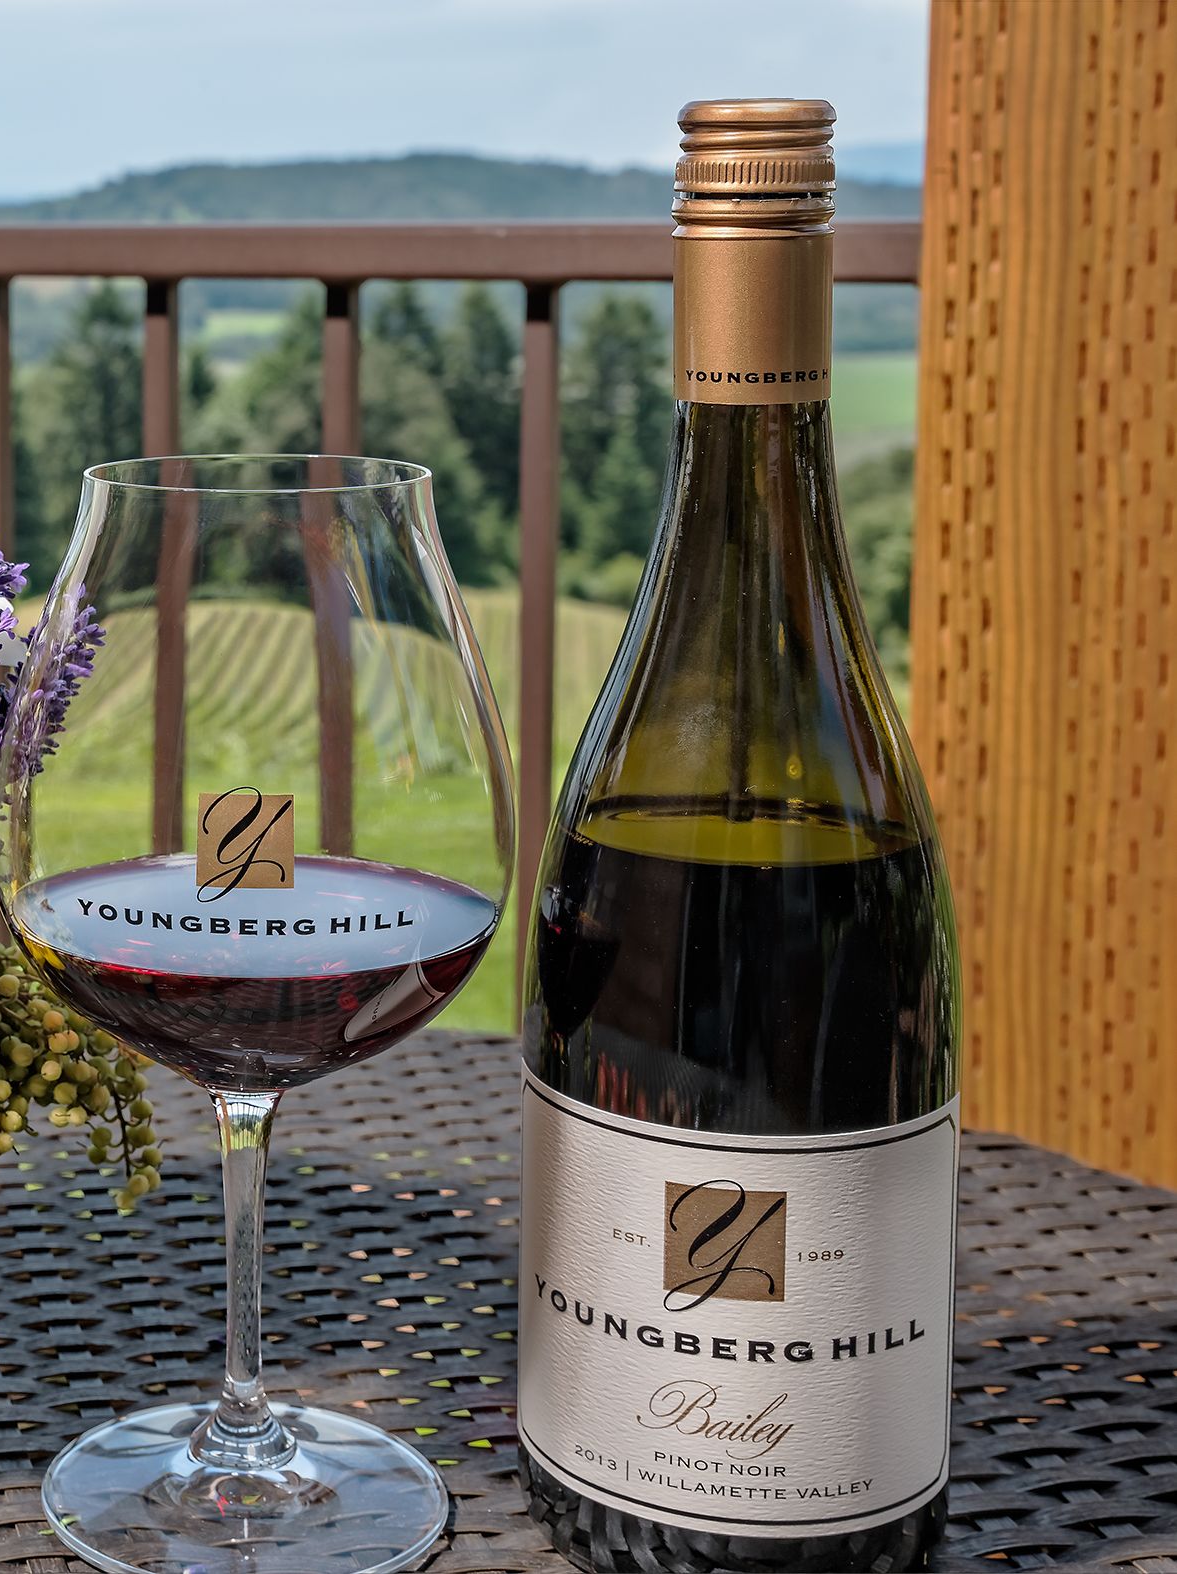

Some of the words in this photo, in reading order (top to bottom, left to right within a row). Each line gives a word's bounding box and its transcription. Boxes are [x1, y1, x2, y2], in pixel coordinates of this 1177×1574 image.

[685, 368, 819, 384] YOUNGBERG
[76, 897, 317, 937] YOUNGBERG
[328, 909, 414, 935] HILL
[611, 1228, 651, 1248] EST.
[796, 1248, 846, 1264] 1989
[534, 1273, 815, 1364] YOUNGBERG
[830, 1320, 926, 1362] HILL
[636, 1379, 795, 1461] Bailey
[574, 1444, 619, 1471] 2013
[637, 1467, 788, 1501] WILLAMETTE
[795, 1478, 875, 1499] VALLEY
[653, 1451, 723, 1474] PINOT
[729, 1464, 788, 1478] NOIR
